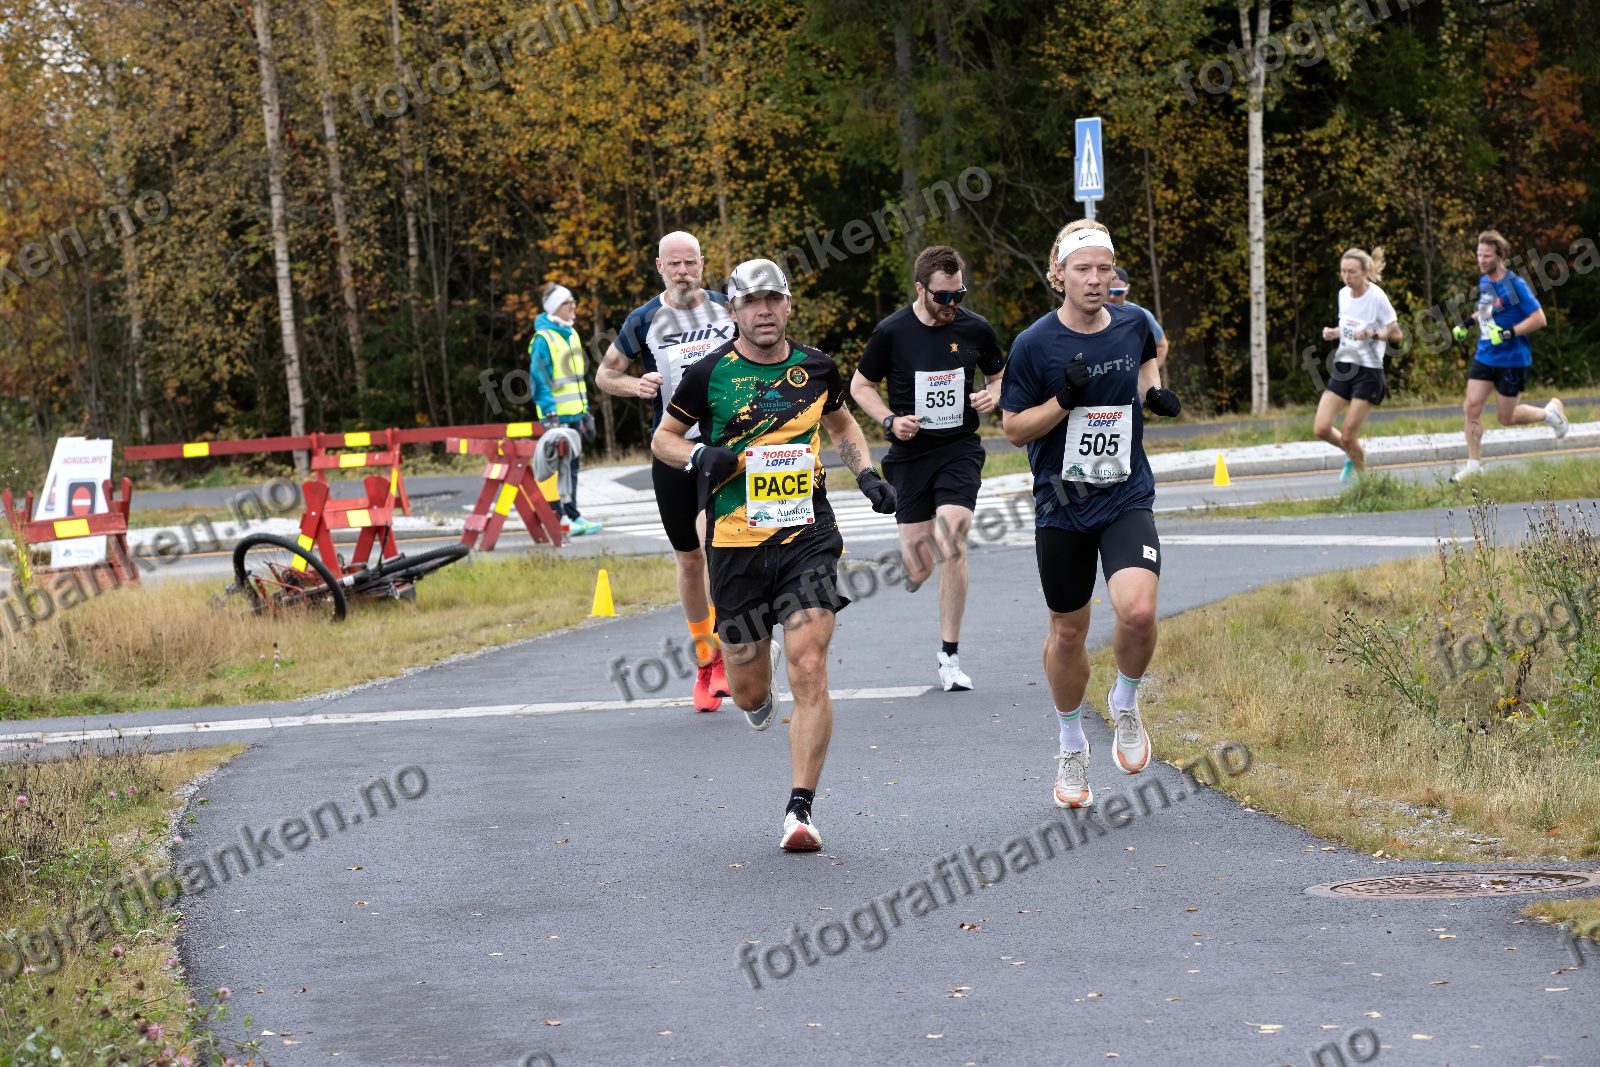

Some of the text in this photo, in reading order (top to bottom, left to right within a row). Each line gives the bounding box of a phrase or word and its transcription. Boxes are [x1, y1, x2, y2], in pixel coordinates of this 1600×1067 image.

[680, 343, 711, 354] NORGES
[683, 350, 707, 359] LØPET
[927, 373, 957, 381] NORGES
[758, 399, 792, 409] Aurskog
[925, 390, 956, 408] 535
[1086, 411, 1123, 420] NORGES
[1087, 419, 1118, 427] LØPET
[1078, 432, 1121, 456] 505
[762, 449, 804, 459] NORGES
[765, 457, 798, 467] LØPET
[754, 473, 808, 497] PACE
